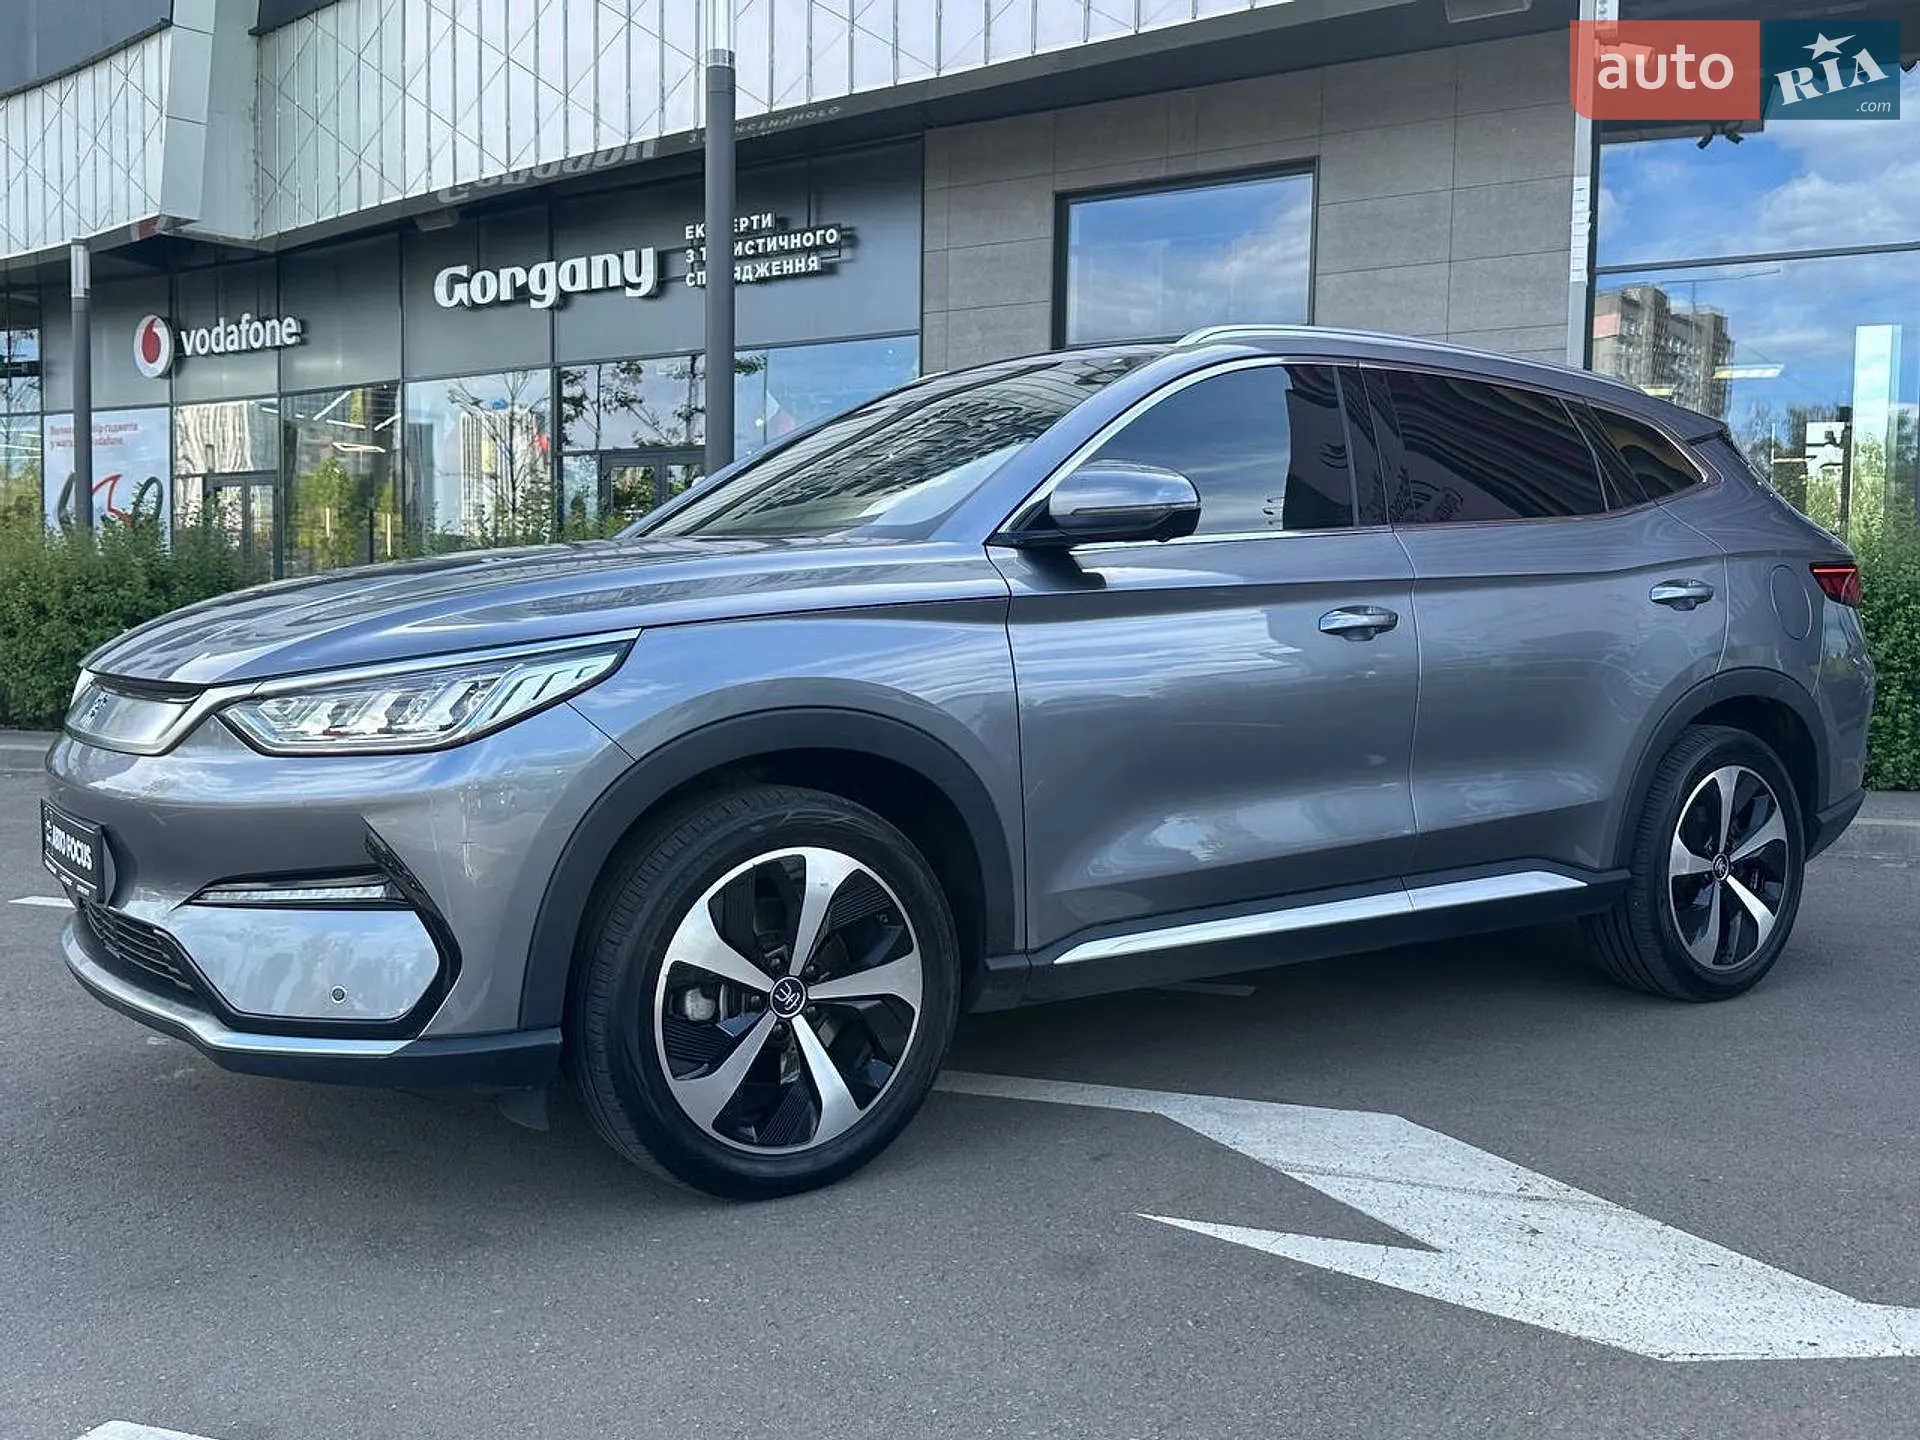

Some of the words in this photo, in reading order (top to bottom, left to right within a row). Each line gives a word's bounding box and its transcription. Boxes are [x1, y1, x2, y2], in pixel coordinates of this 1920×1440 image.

[685, 213, 773, 240] ЕКРТИ
[699, 228, 838, 262] ТИСТИЧНОГО
[434, 247, 656, 309] Gorgany
[685, 256, 819, 287] СПЯДЖЕННЯ
[180, 312, 299, 356] vodafone
[66, 834, 93, 871] FOCUS
